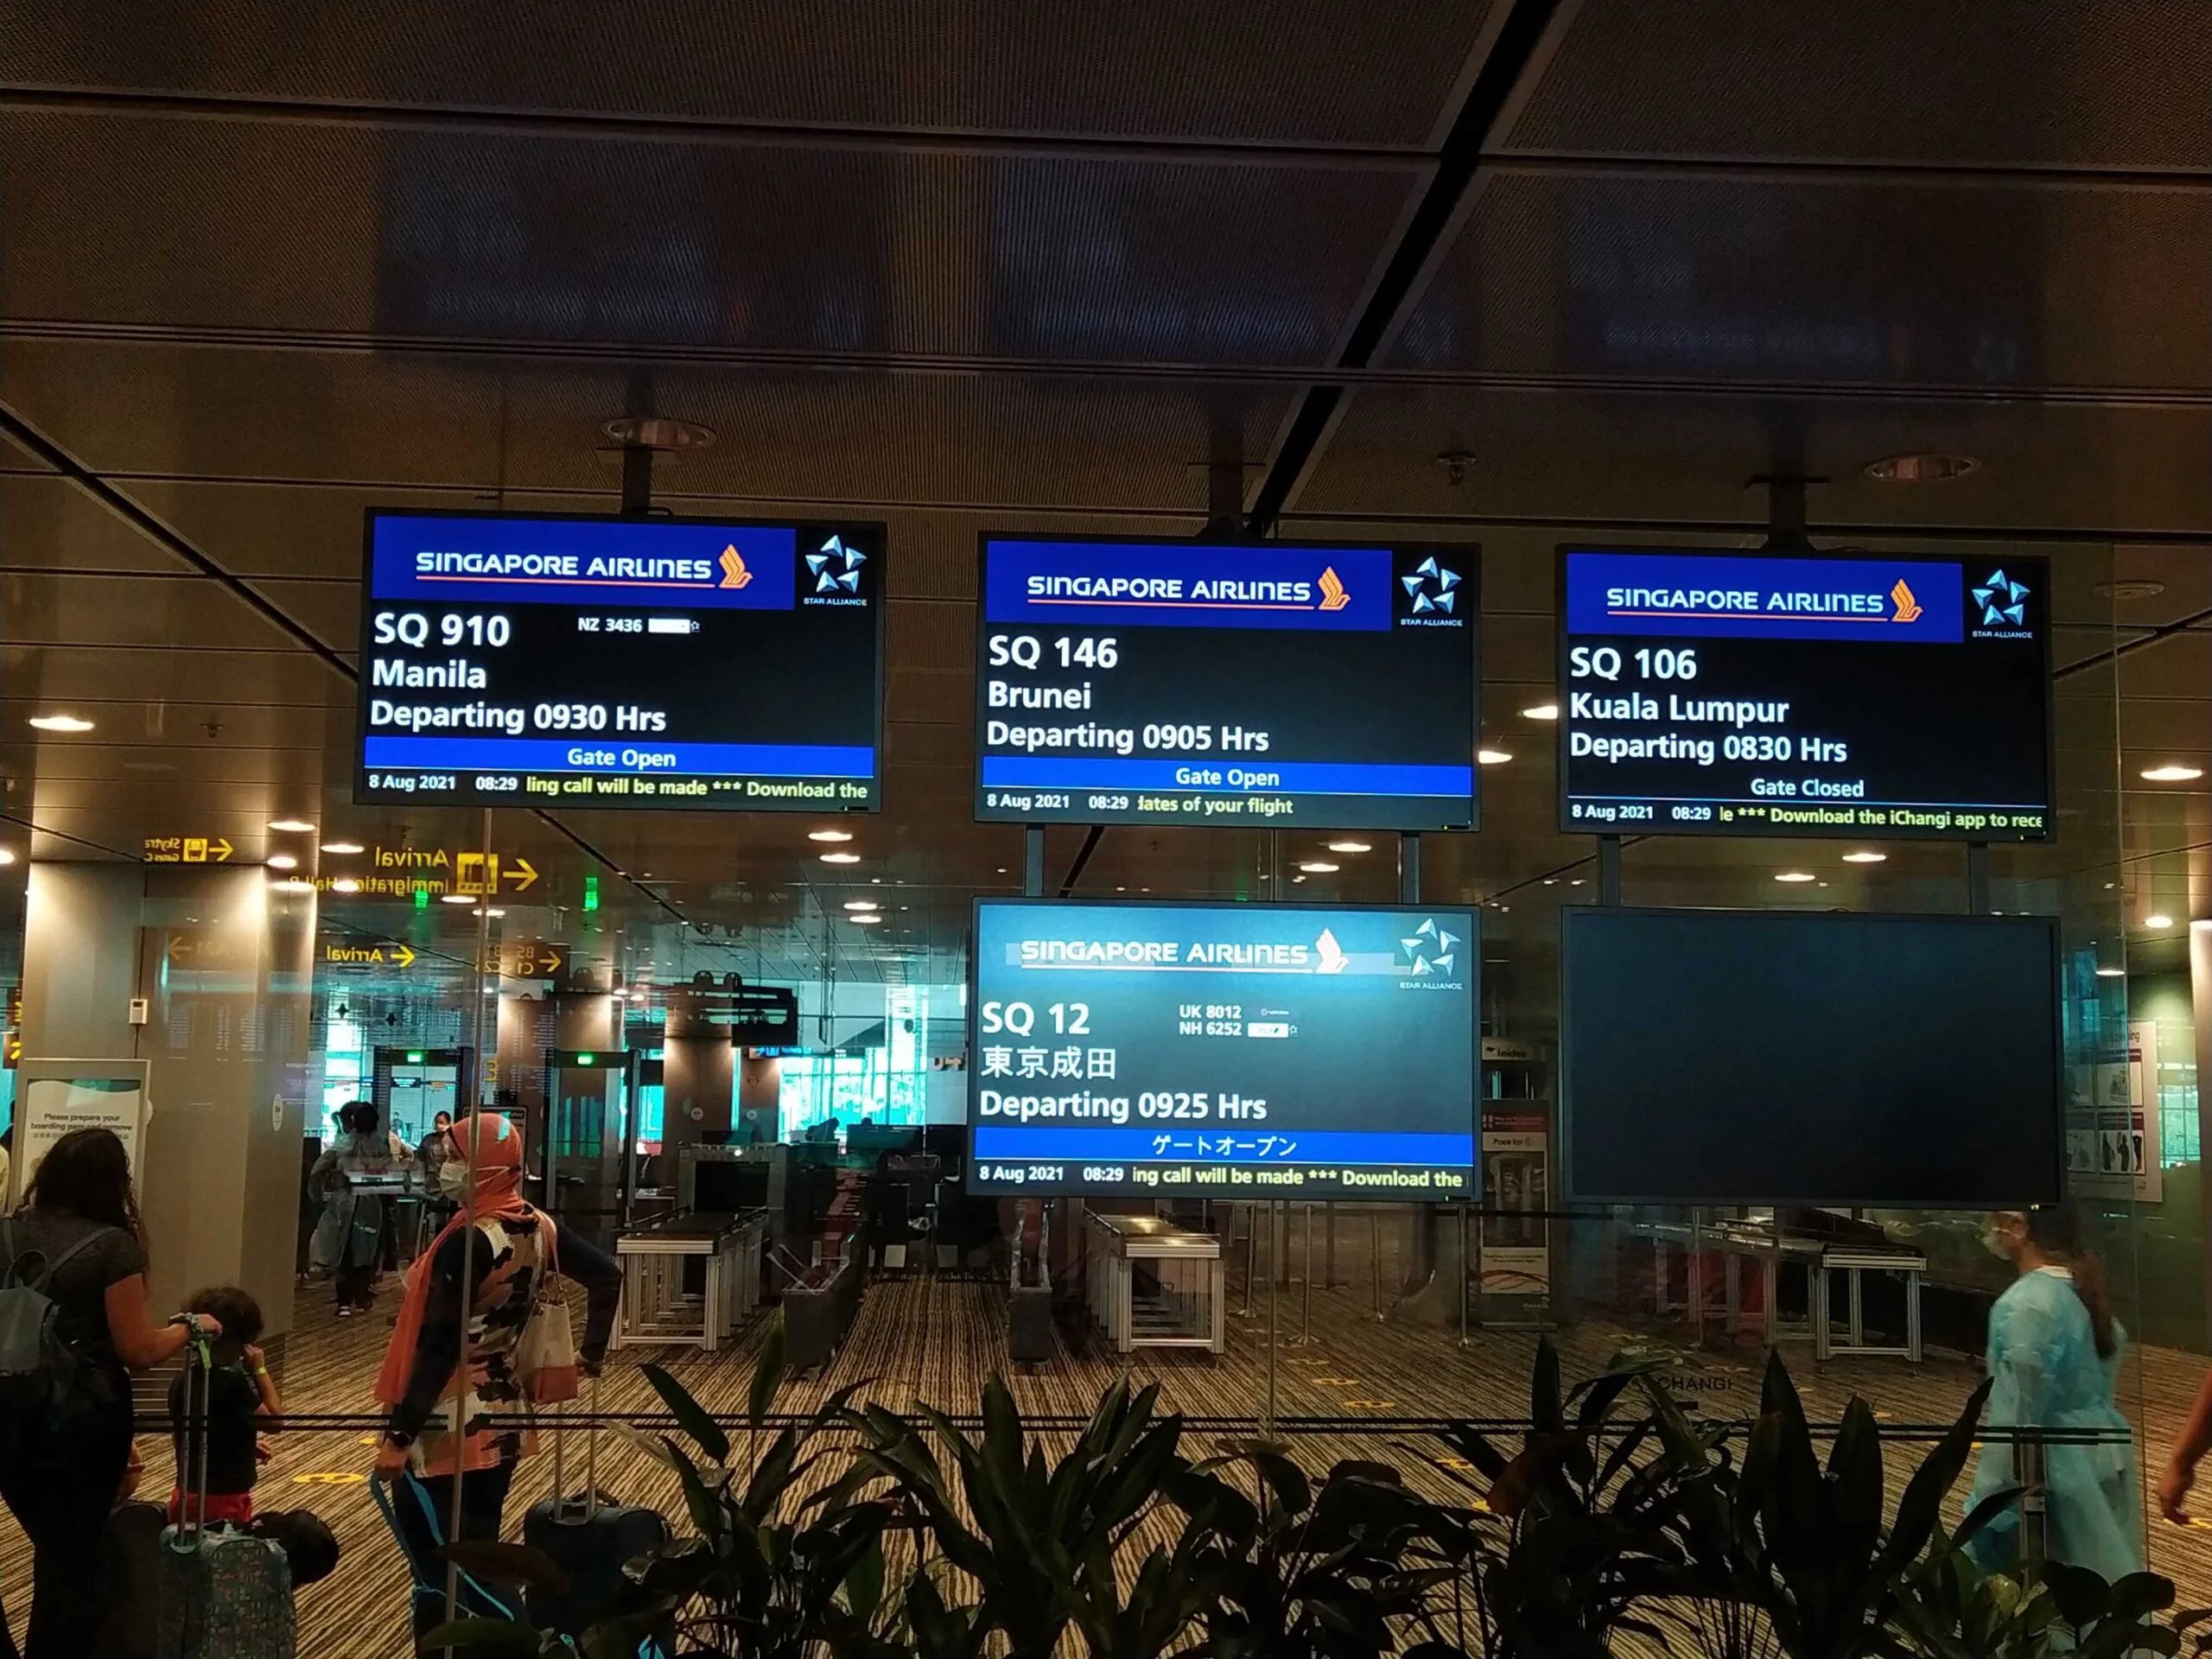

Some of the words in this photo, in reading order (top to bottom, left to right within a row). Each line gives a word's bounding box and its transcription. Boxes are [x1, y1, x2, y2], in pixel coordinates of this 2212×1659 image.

[416, 552, 579, 577] SINGAPORE
[586, 556, 712, 580] AIRLINES
[1027, 575, 1183, 599] SINGAPORE
[1190, 580, 1311, 601] AIRLINES
[826, 598, 868, 607] ALLIANCE
[1606, 588, 1759, 610] SINGAPORE
[1766, 592, 1884, 613] AIRLINES
[374, 612, 429, 648] SQ
[441, 613, 510, 647] 910
[578, 617, 601, 632] NZ
[605, 618, 643, 633] 3436
[1422, 619, 1463, 627] ALLIANCE
[1993, 631, 2033, 639] ALLIANCE
[988, 634, 1041, 670] SQ
[1054, 637, 1118, 669] 146
[372, 658, 486, 689] Manila
[1570, 646, 1622, 681] SQ
[1634, 648, 1697, 680] 106
[988, 680, 1091, 709] Brunei
[371, 699, 525, 735] Departing
[533, 703, 607, 730] 0930
[616, 705, 666, 732] Hrs
[1571, 691, 1659, 721] Kuala
[1669, 694, 1789, 729] Lumpur
[988, 721, 1135, 755] Departing
[1142, 723, 1212, 750] 0905
[1221, 726, 1269, 752] Hrs
[567, 747, 616, 766] Gate
[621, 748, 677, 771] Open
[1571, 732, 1714, 766] Departing
[1724, 734, 1791, 761] 0830
[1801, 737, 1847, 763] Hrs
[368, 773, 379, 789] 8
[382, 774, 416, 792] Aug
[418, 775, 455, 790] 2021
[475, 776, 518, 791] 08:29
[563, 777, 593, 793] call
[596, 778, 630, 794] will
[632, 778, 656, 794] be
[659, 779, 709, 796] made
[747, 781, 836, 798] Download
[838, 782, 868, 798] the
[1175, 767, 1223, 785] Gate
[1227, 768, 1280, 790] Open
[1751, 778, 1796, 796] Gate
[1802, 779, 1865, 798] Closed
[987, 793, 997, 807] 8
[1000, 793, 1032, 811] Aug
[1034, 794, 1070, 809] 2021
[1088, 795, 1129, 810] 08:29
[1182, 796, 1202, 812] of
[1205, 800, 1244, 816] your
[1247, 797, 1294, 817] flight
[1572, 804, 1582, 818] 8
[1584, 804, 1616, 822] Aug
[1618, 805, 1653, 819] 2021
[1671, 805, 1712, 821] 08:29
[1770, 807, 1855, 824] Download
[1859, 809, 1886, 825] the
[1890, 809, 1951, 830] iChangi
[1955, 814, 1986, 830] app
[1988, 813, 2008, 827] to
[2012, 816, 2043, 828] rece
[1020, 938, 1180, 963] SINGAPORE
[1185, 944, 1310, 966] AIRLINES
[1399, 981, 1421, 989] STAR
[1421, 982, 1463, 990] ALLIANCE
[982, 1001, 1035, 1037] SQ
[1048, 1002, 1090, 1034] 12
[1179, 1004, 1202, 1019] UK
[1205, 1005, 1242, 1020] 8012
[1179, 1021, 1203, 1035] NH
[1205, 1021, 1243, 1036] 6252
[981, 1045, 1116, 1080] 東京成田
[43, 1112, 69, 1122] Please
[69, 1114, 101, 1123] prepare
[103, 1114, 121, 1123] your
[980, 1090, 1129, 1124] Departing
[1138, 1091, 1209, 1119] 0925
[1218, 1093, 1268, 1120] Hrs
[30, 1122, 67, 1132] boarding
[1152, 1135, 1297, 1157] ゲートオープン
[979, 1165, 990, 1180] 8
[992, 1166, 1025, 1184] Aug
[1027, 1166, 1064, 1181] 2021
[1083, 1166, 1124, 1182] 08:29
[1133, 1166, 1159, 1186] ing
[1162, 1167, 1192, 1183] call
[1195, 1167, 1227, 1184] will
[1230, 1167, 1253, 1184] be
[1256, 1169, 1304, 1185] made
[1342, 1170, 1430, 1187] Download
[1433, 1172, 1463, 1187] the
[1659, 1376, 1732, 1390] CHANGI
